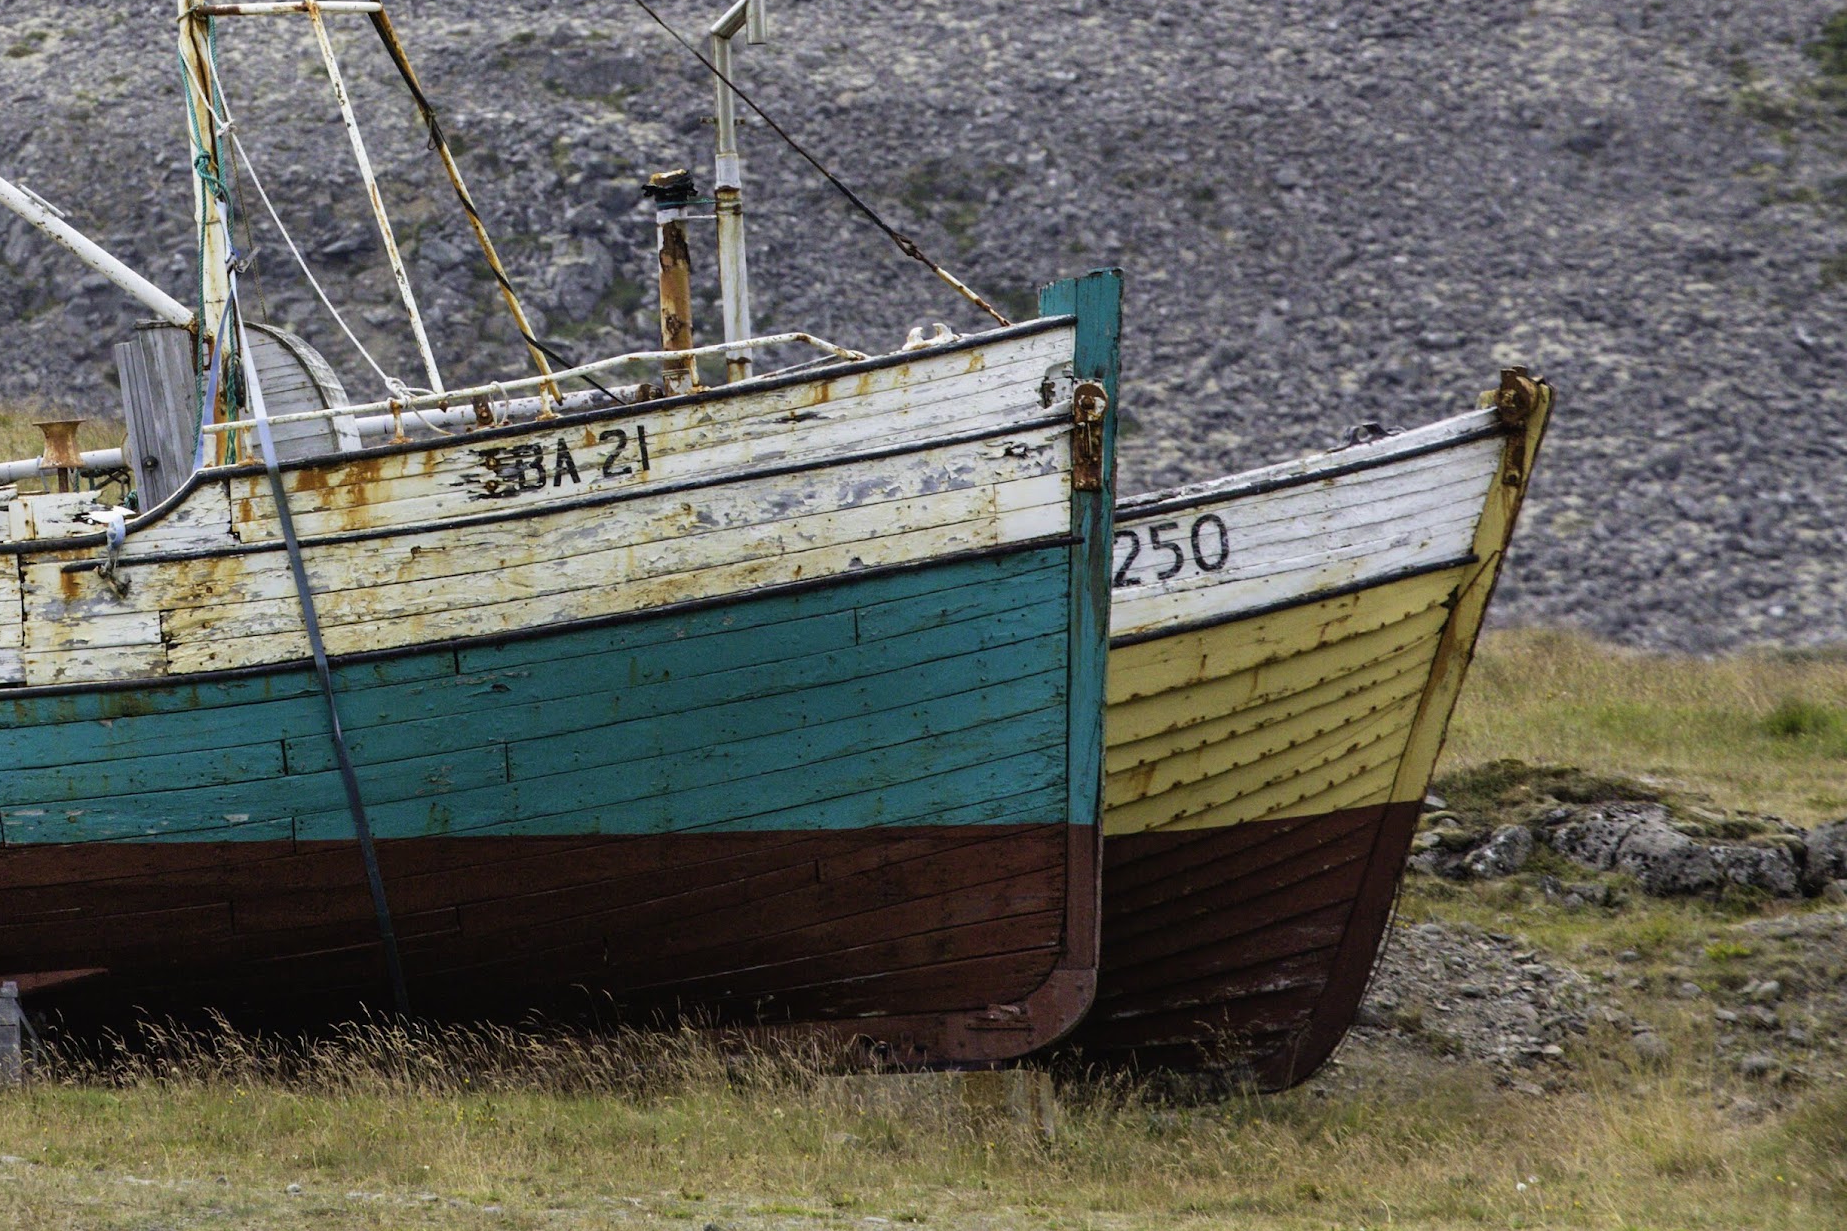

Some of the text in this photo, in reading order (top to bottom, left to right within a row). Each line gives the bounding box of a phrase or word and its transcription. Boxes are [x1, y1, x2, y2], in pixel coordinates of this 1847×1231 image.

[515, 424, 651, 490] BA 21
[1112, 513, 1230, 588] 250
